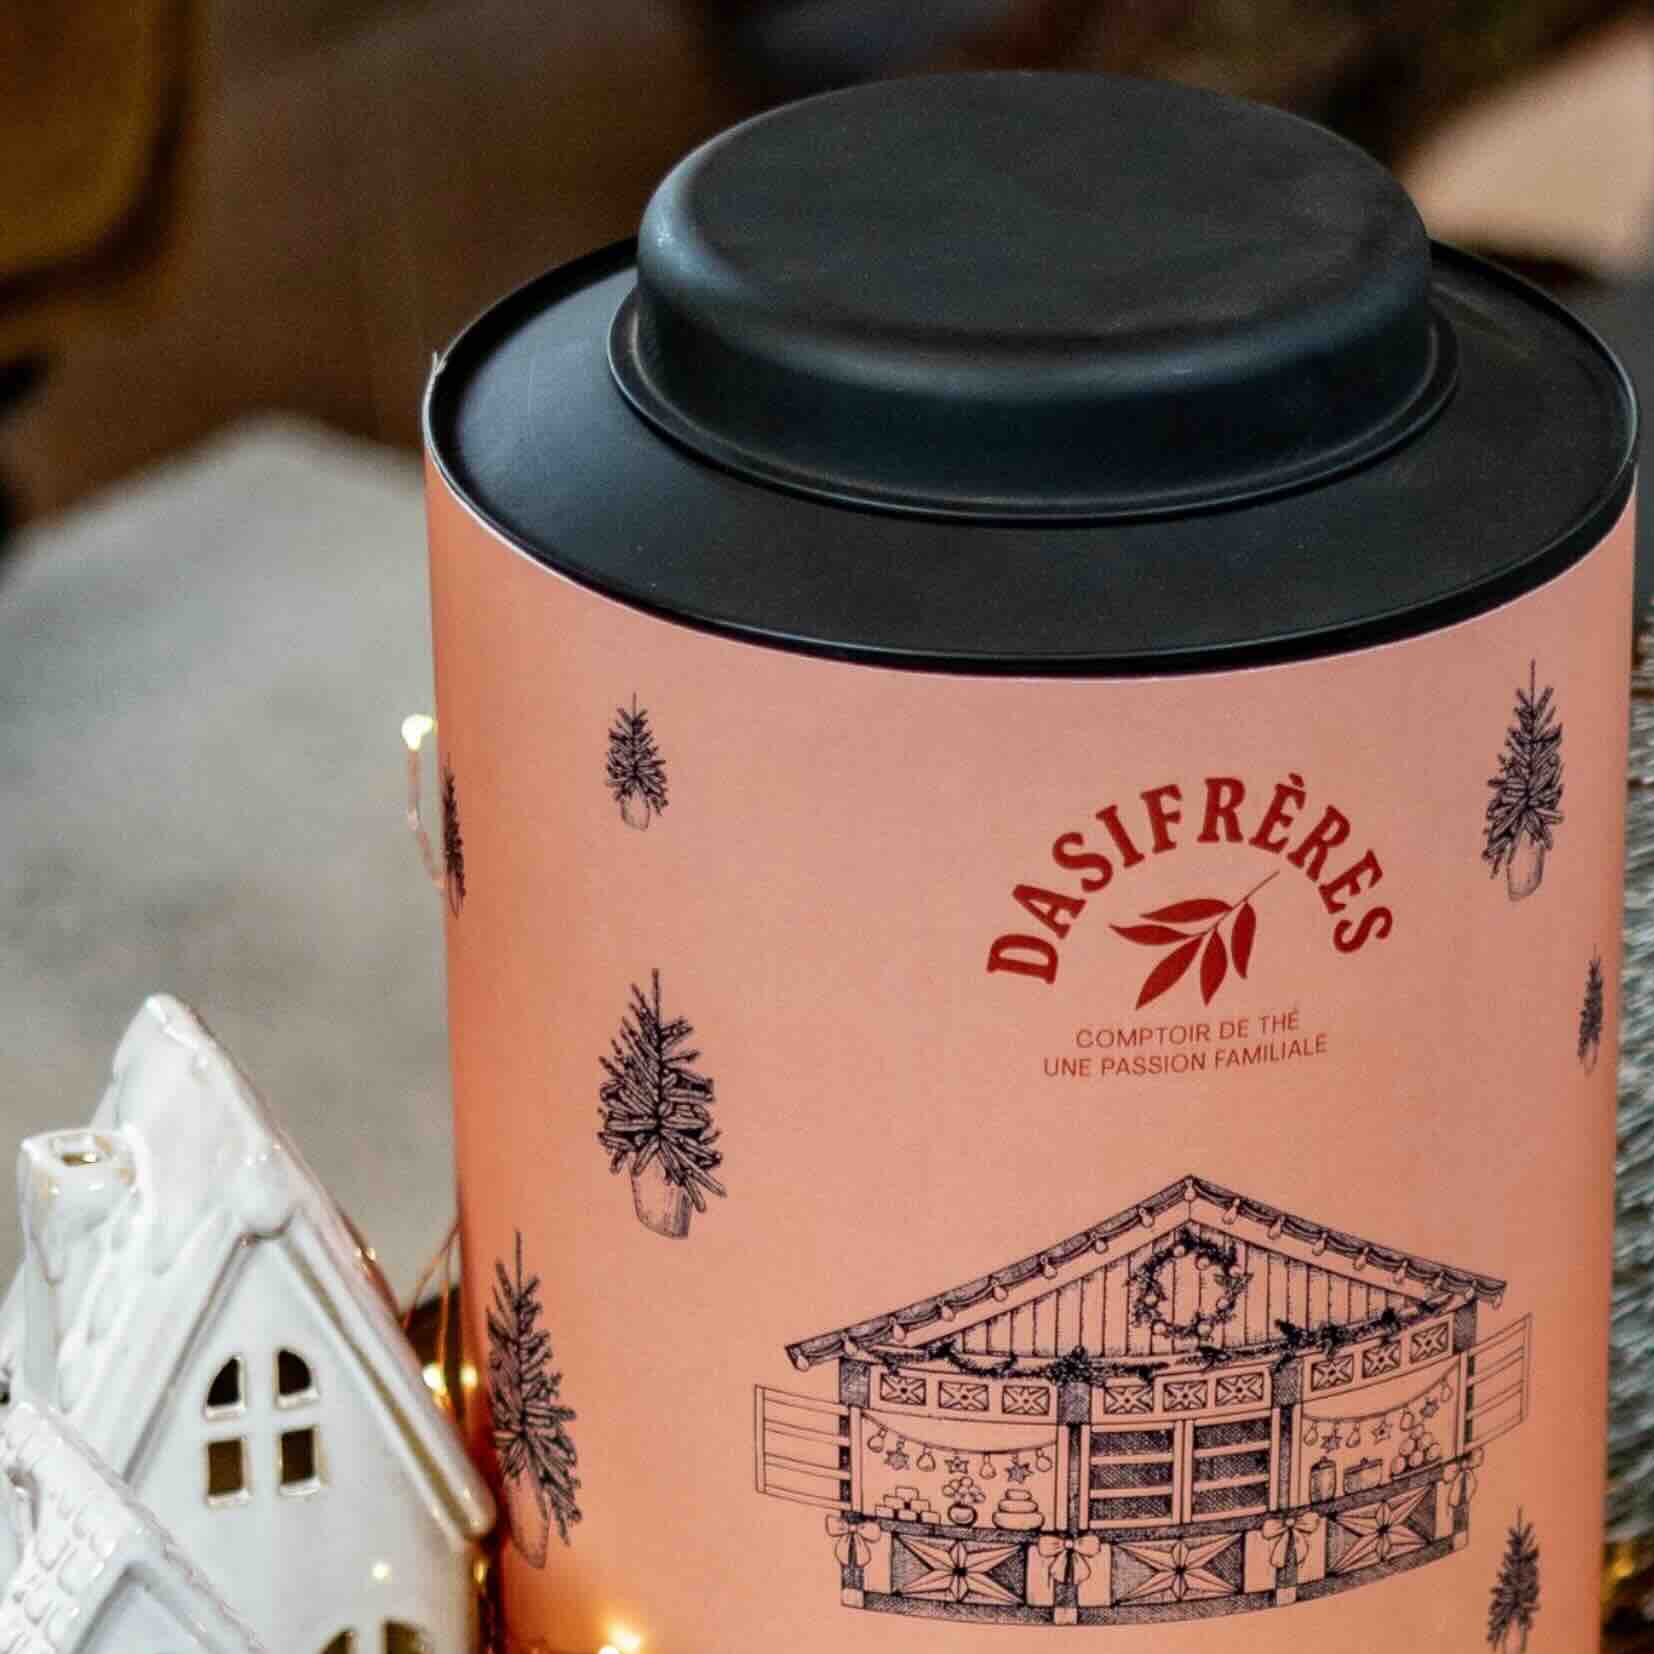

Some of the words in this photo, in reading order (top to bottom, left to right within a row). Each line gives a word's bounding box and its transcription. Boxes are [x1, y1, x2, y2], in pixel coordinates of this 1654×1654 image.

[1075, 1023, 1212, 1049] COMPTOIR
[1219, 1019, 1250, 1040] DE
[1043, 1055, 1091, 1078] UNE
[1100, 1051, 1207, 1076] PASSION
[1214, 1033, 1328, 1070] FAMILIALE
